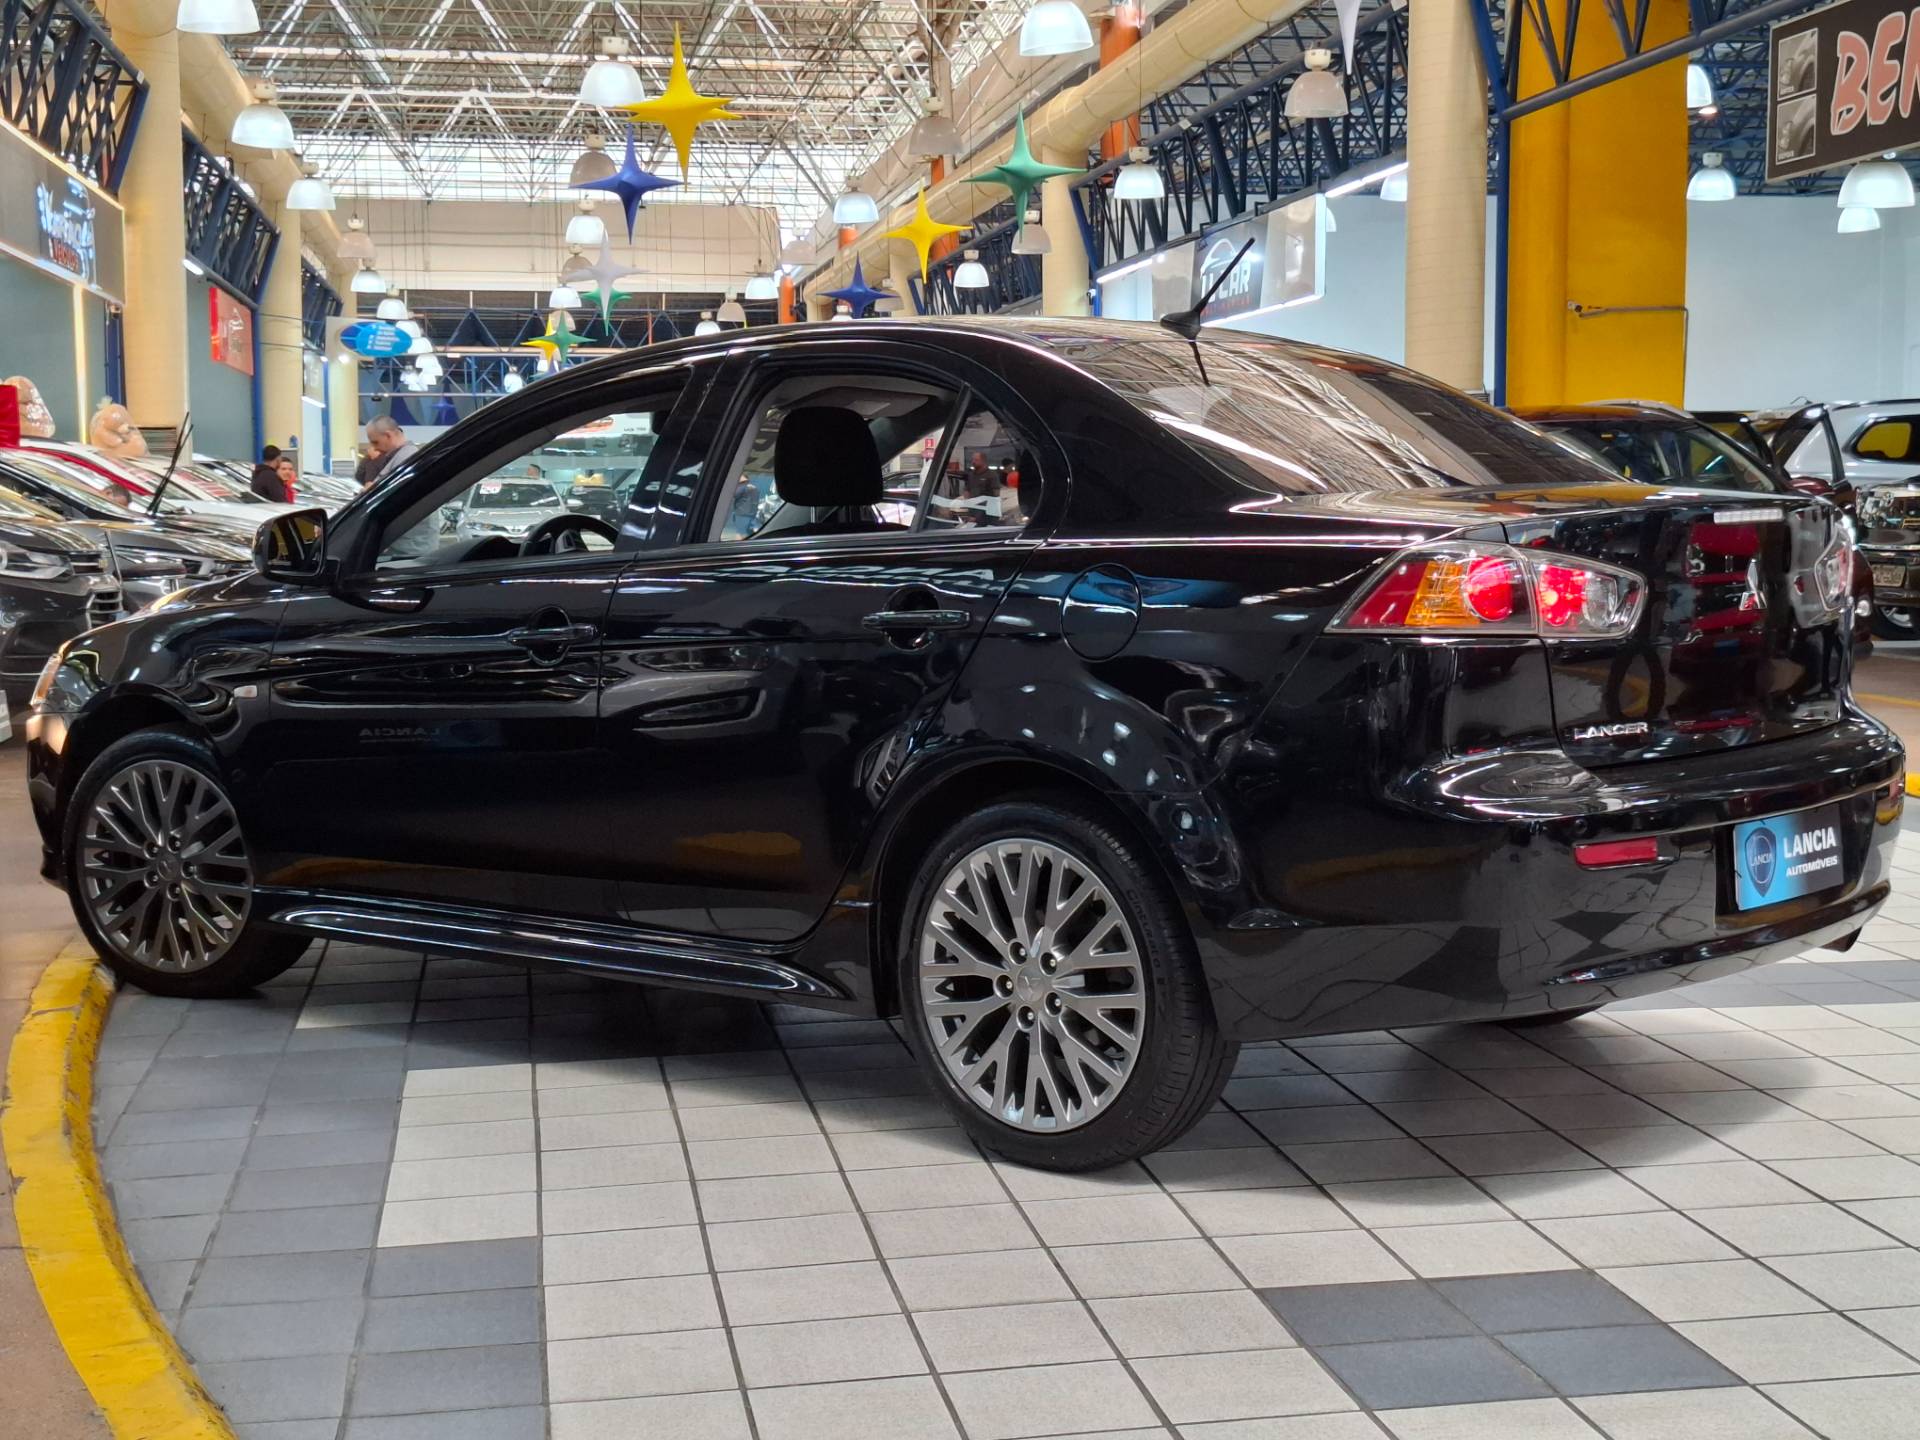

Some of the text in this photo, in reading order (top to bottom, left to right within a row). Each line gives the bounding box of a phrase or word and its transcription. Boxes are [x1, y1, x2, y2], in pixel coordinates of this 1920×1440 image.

[1574, 721, 1649, 740] LANCER
[1783, 826, 1837, 859] LANCIA
[1750, 852, 1775, 867] LANCIA
[1785, 855, 1838, 878] AUTOMÓVEIS
